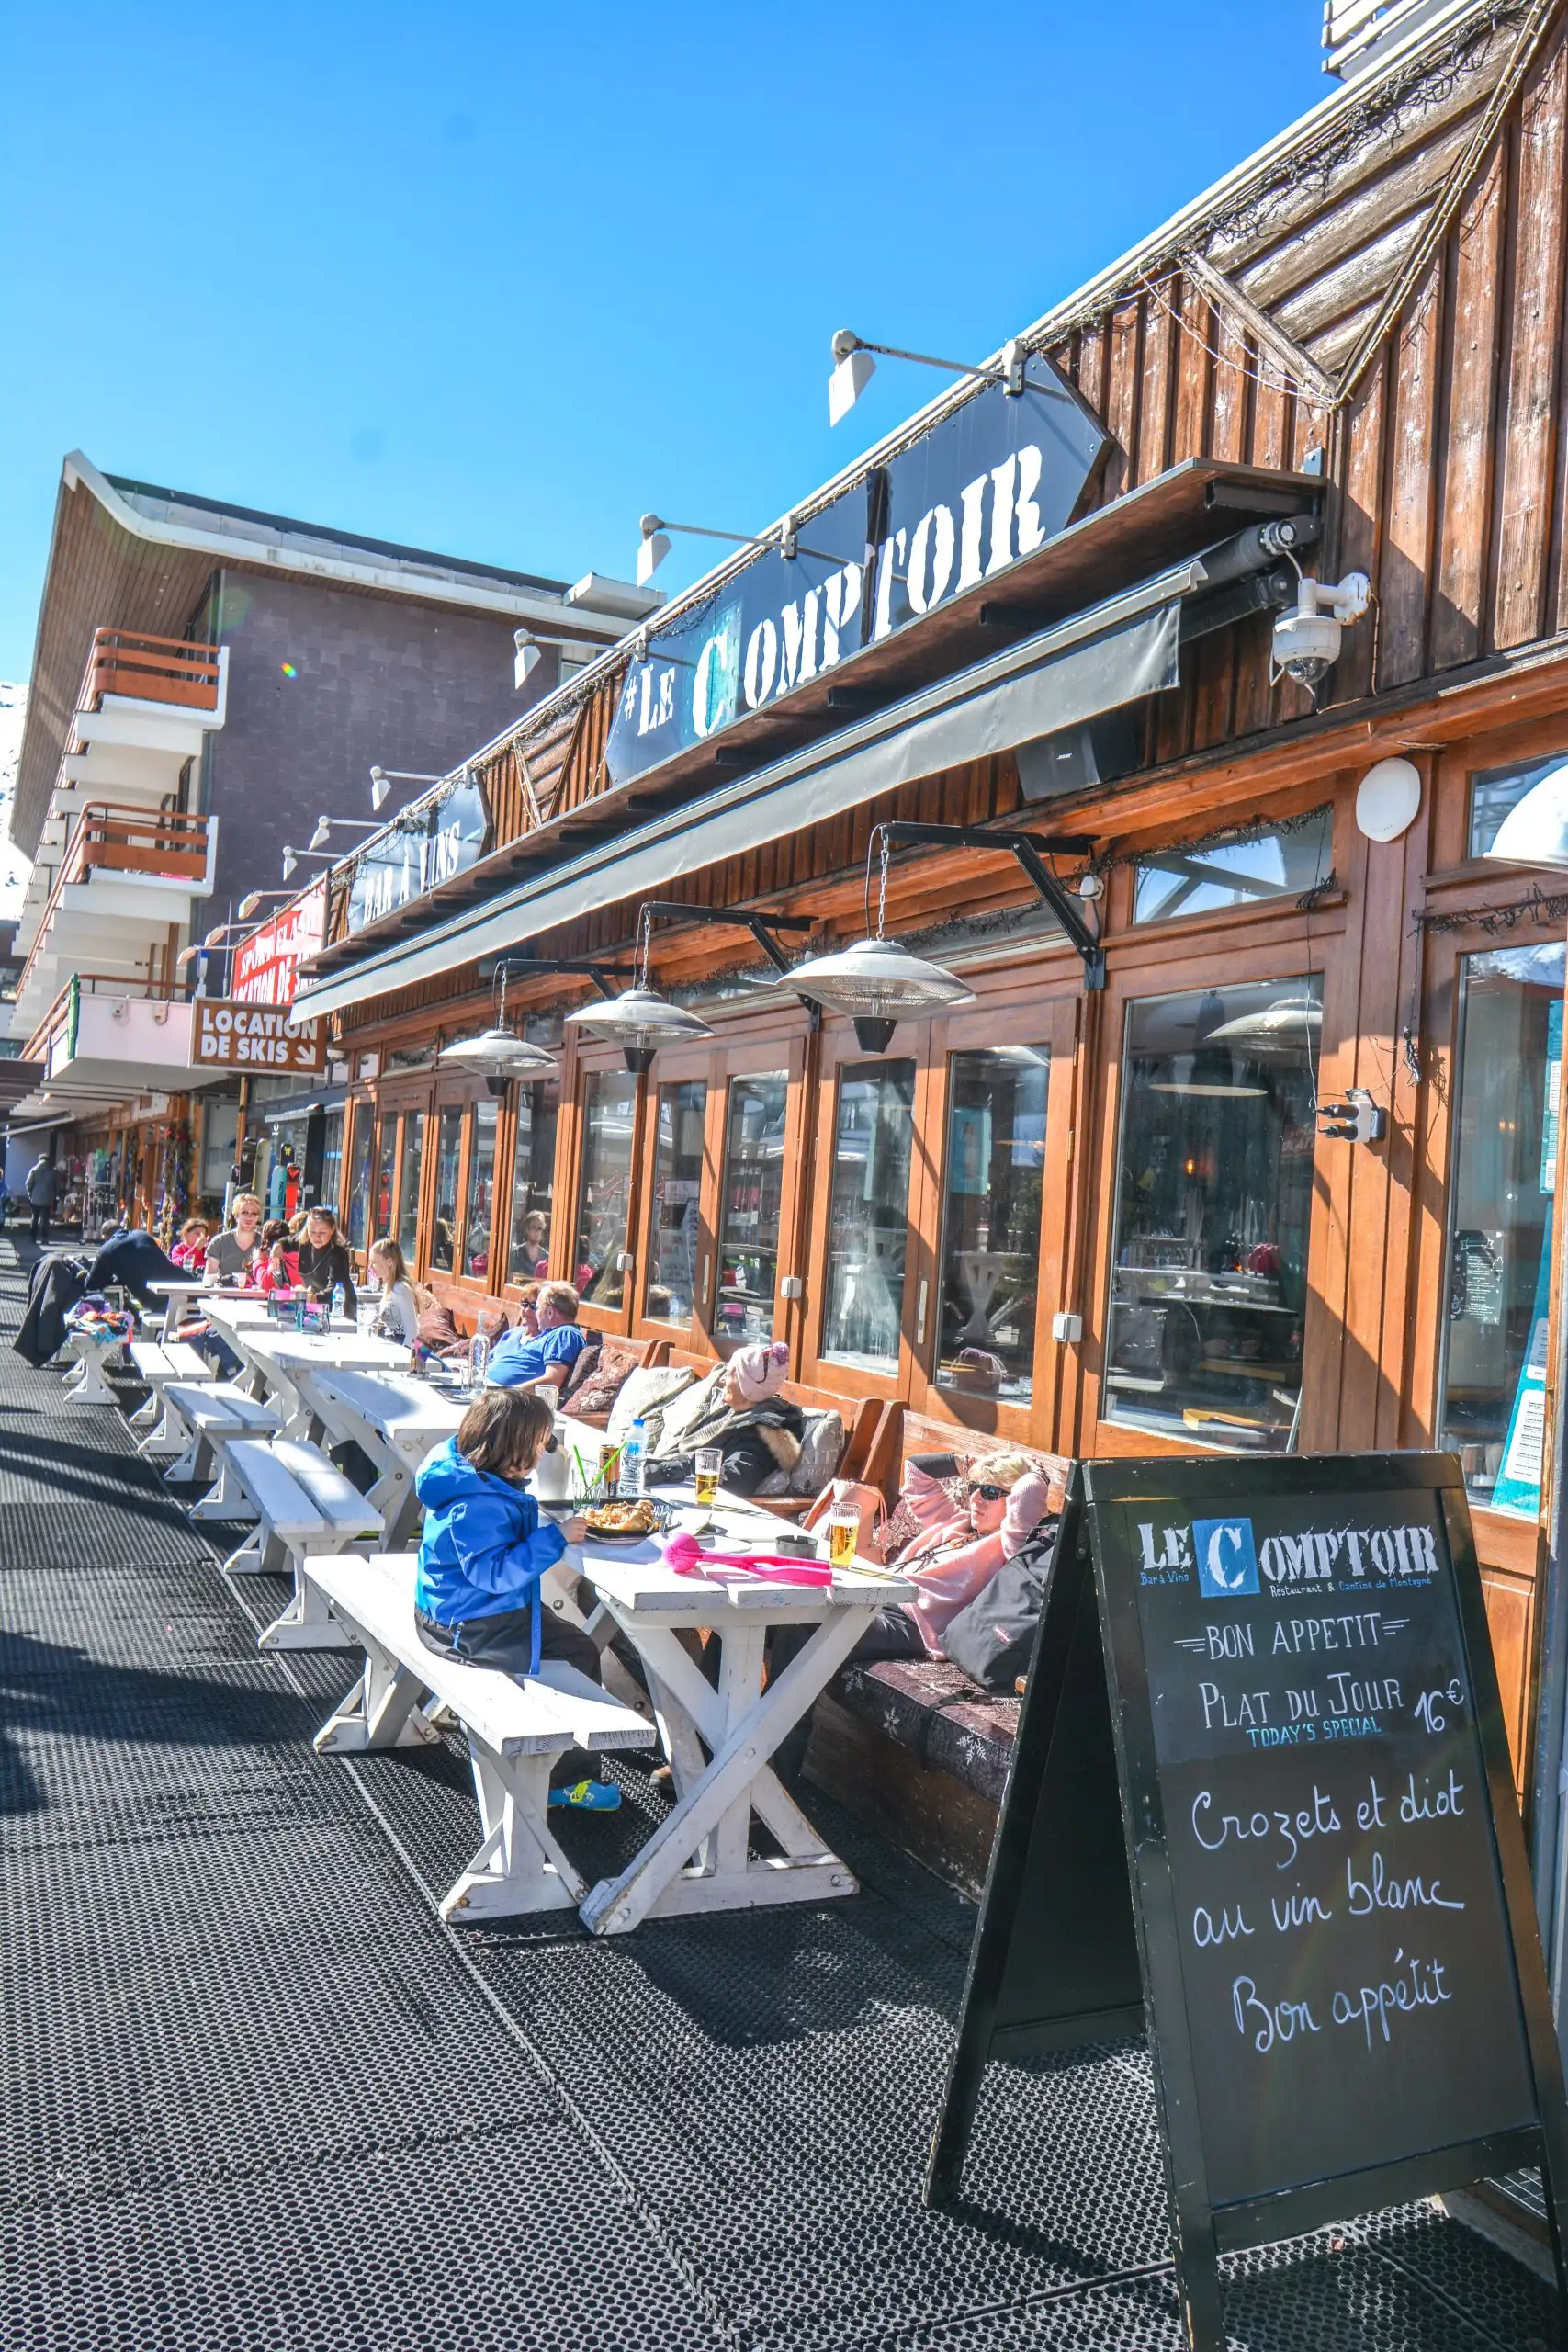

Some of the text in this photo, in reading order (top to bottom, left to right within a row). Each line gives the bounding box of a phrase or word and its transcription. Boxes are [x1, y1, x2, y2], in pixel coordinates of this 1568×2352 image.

[692, 444, 1046, 739] COMPTOIR
[363, 866, 393, 926] BAR
[419, 820, 460, 893] VINS
[240, 934, 275, 978] SPORT
[276, 956, 291, 1004] DE
[202, 1008, 318, 1040] LOCATION
[200, 1034, 288, 1064] DE SKIS
[1137, 1521, 1439, 1590] LE COMPTOIR
[1140, 1571, 1157, 1586] Bar
[1167, 1570, 1190, 1583] Vins
[1269, 1576, 1432, 1597] Restaurant & Cantine de Montagne
[1206, 1612, 1382, 1660] BON APPETIT
[1198, 1682, 1271, 1729] PLAT
[1246, 1716, 1382, 1748] TODAY'S SPECIAL
[1192, 1769, 1464, 1870] Crozets et diot
[1193, 1851, 1465, 1947] au vin blanc
[1232, 1948, 1452, 2052] Bon appétit
